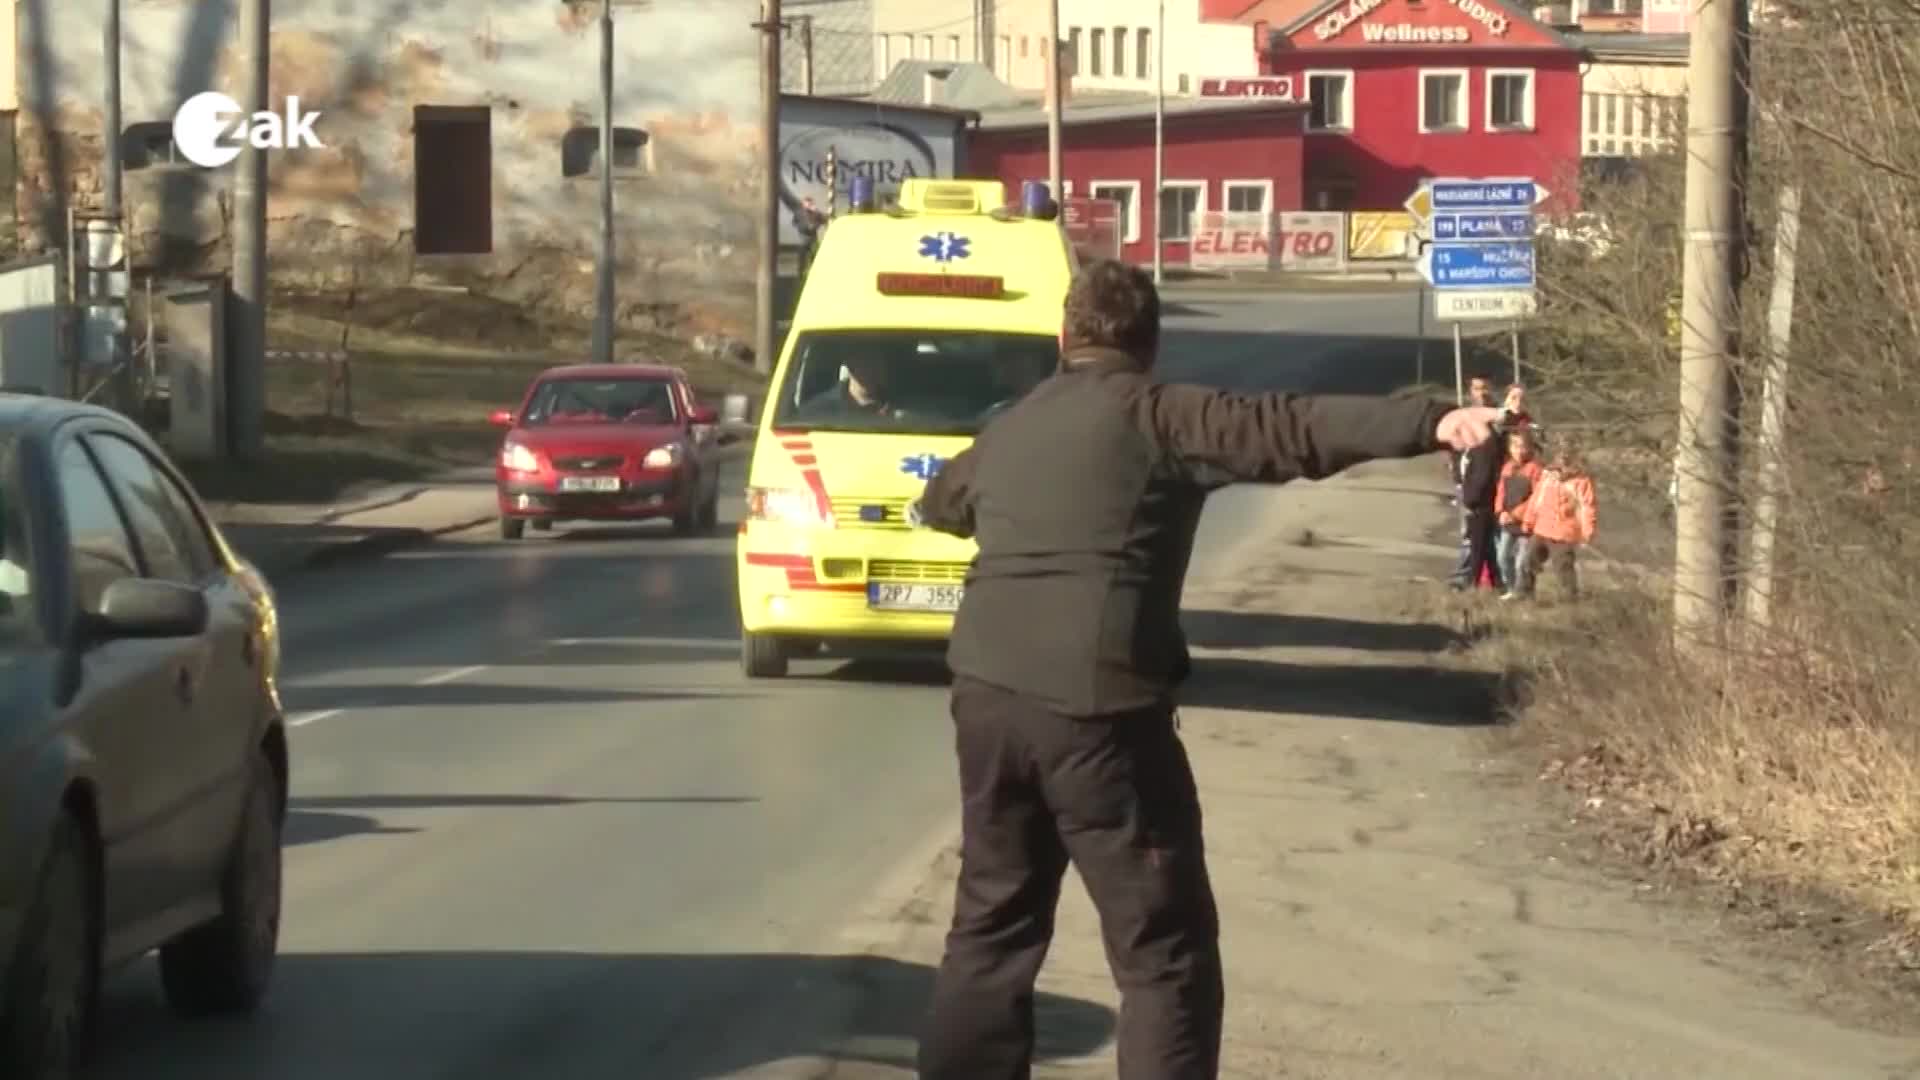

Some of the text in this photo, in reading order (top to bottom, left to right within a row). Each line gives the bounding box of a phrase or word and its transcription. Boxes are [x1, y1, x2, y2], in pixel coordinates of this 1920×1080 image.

[1448, 0, 1513, 36] UDIO
[1361, 23, 1469, 42] Wellness
[1201, 80, 1288, 97] ELEKTRO
[790, 159, 918, 186] NOMIRA
[1193, 230, 1335, 257] ELEKTRO
[1452, 297, 1504, 313] CENTRUM
